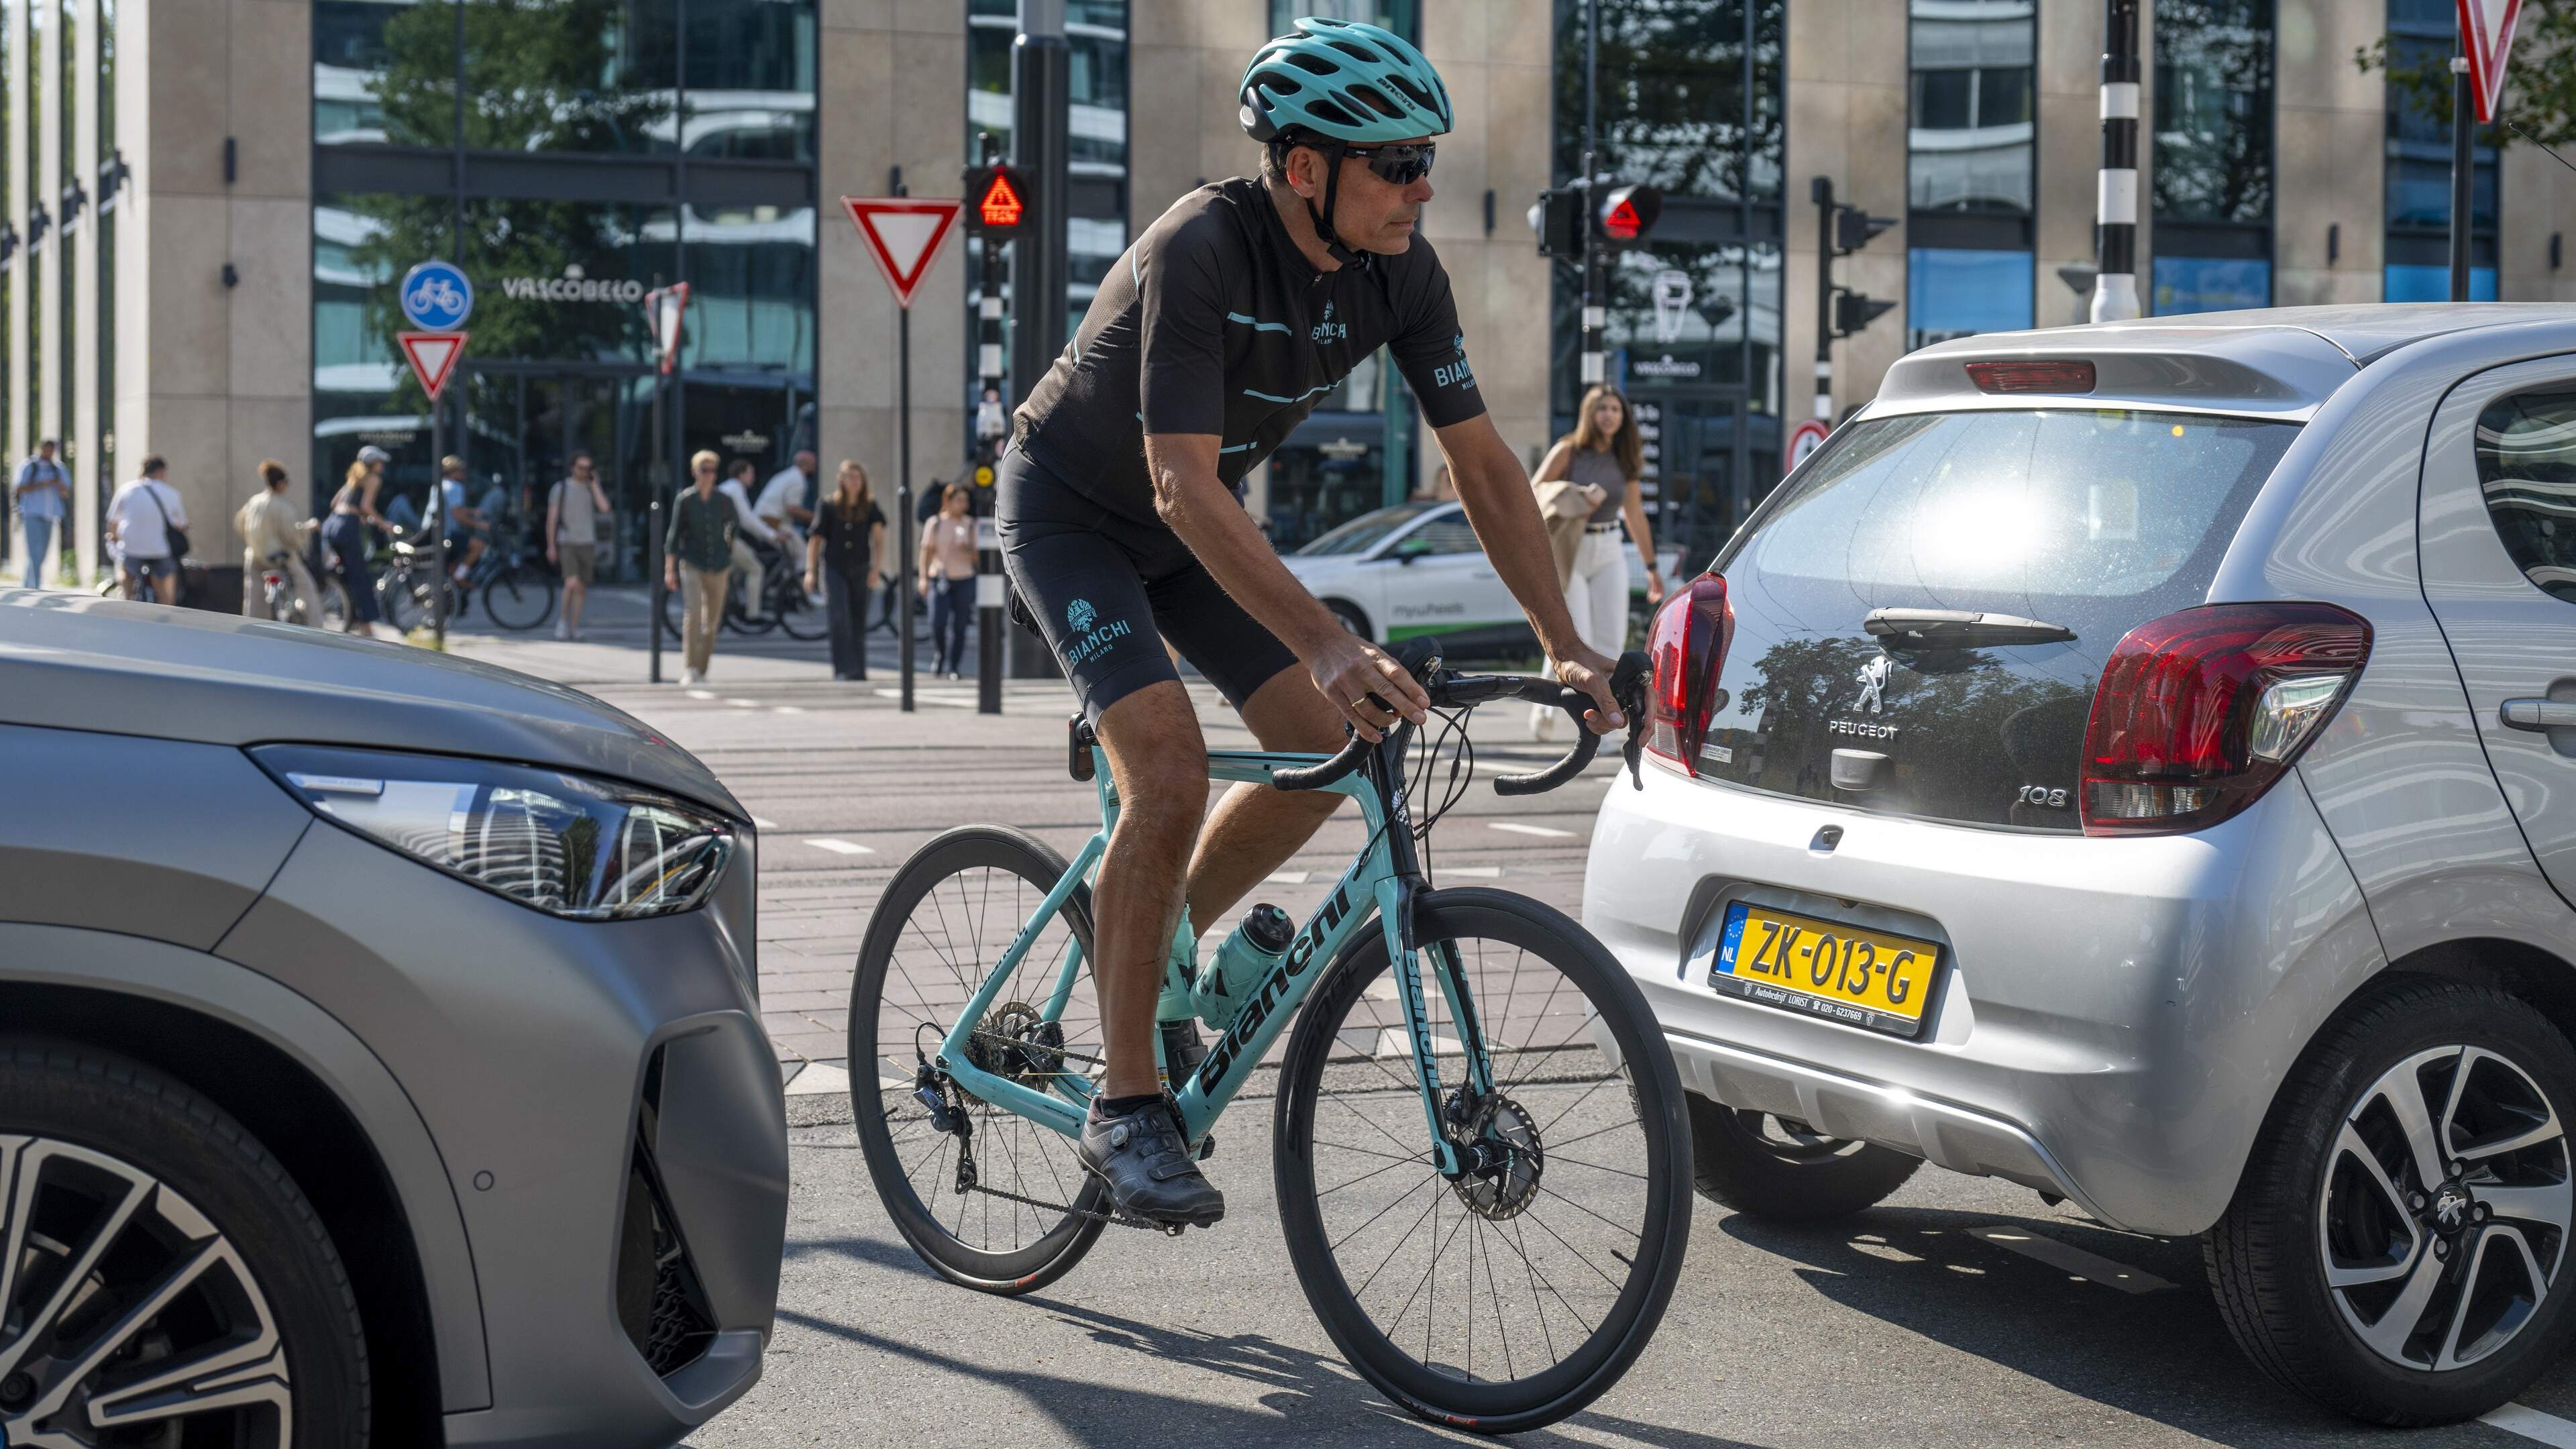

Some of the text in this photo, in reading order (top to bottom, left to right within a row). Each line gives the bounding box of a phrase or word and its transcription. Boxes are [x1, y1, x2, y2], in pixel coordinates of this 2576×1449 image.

[1434, 358, 1471, 387] BIAN
[1069, 620, 1131, 666] BIANCHI
[1089, 644, 1113, 663] MILANO
[1829, 720, 1898, 740] PEUGEOT
[2019, 785, 2067, 807] 108
[1721, 945, 1735, 963] NL
[1750, 920, 1915, 1004] ZK-013-G
[1755, 987, 1788, 1004] Autobedrijf
[1788, 994, 1809, 1008] LORIST
